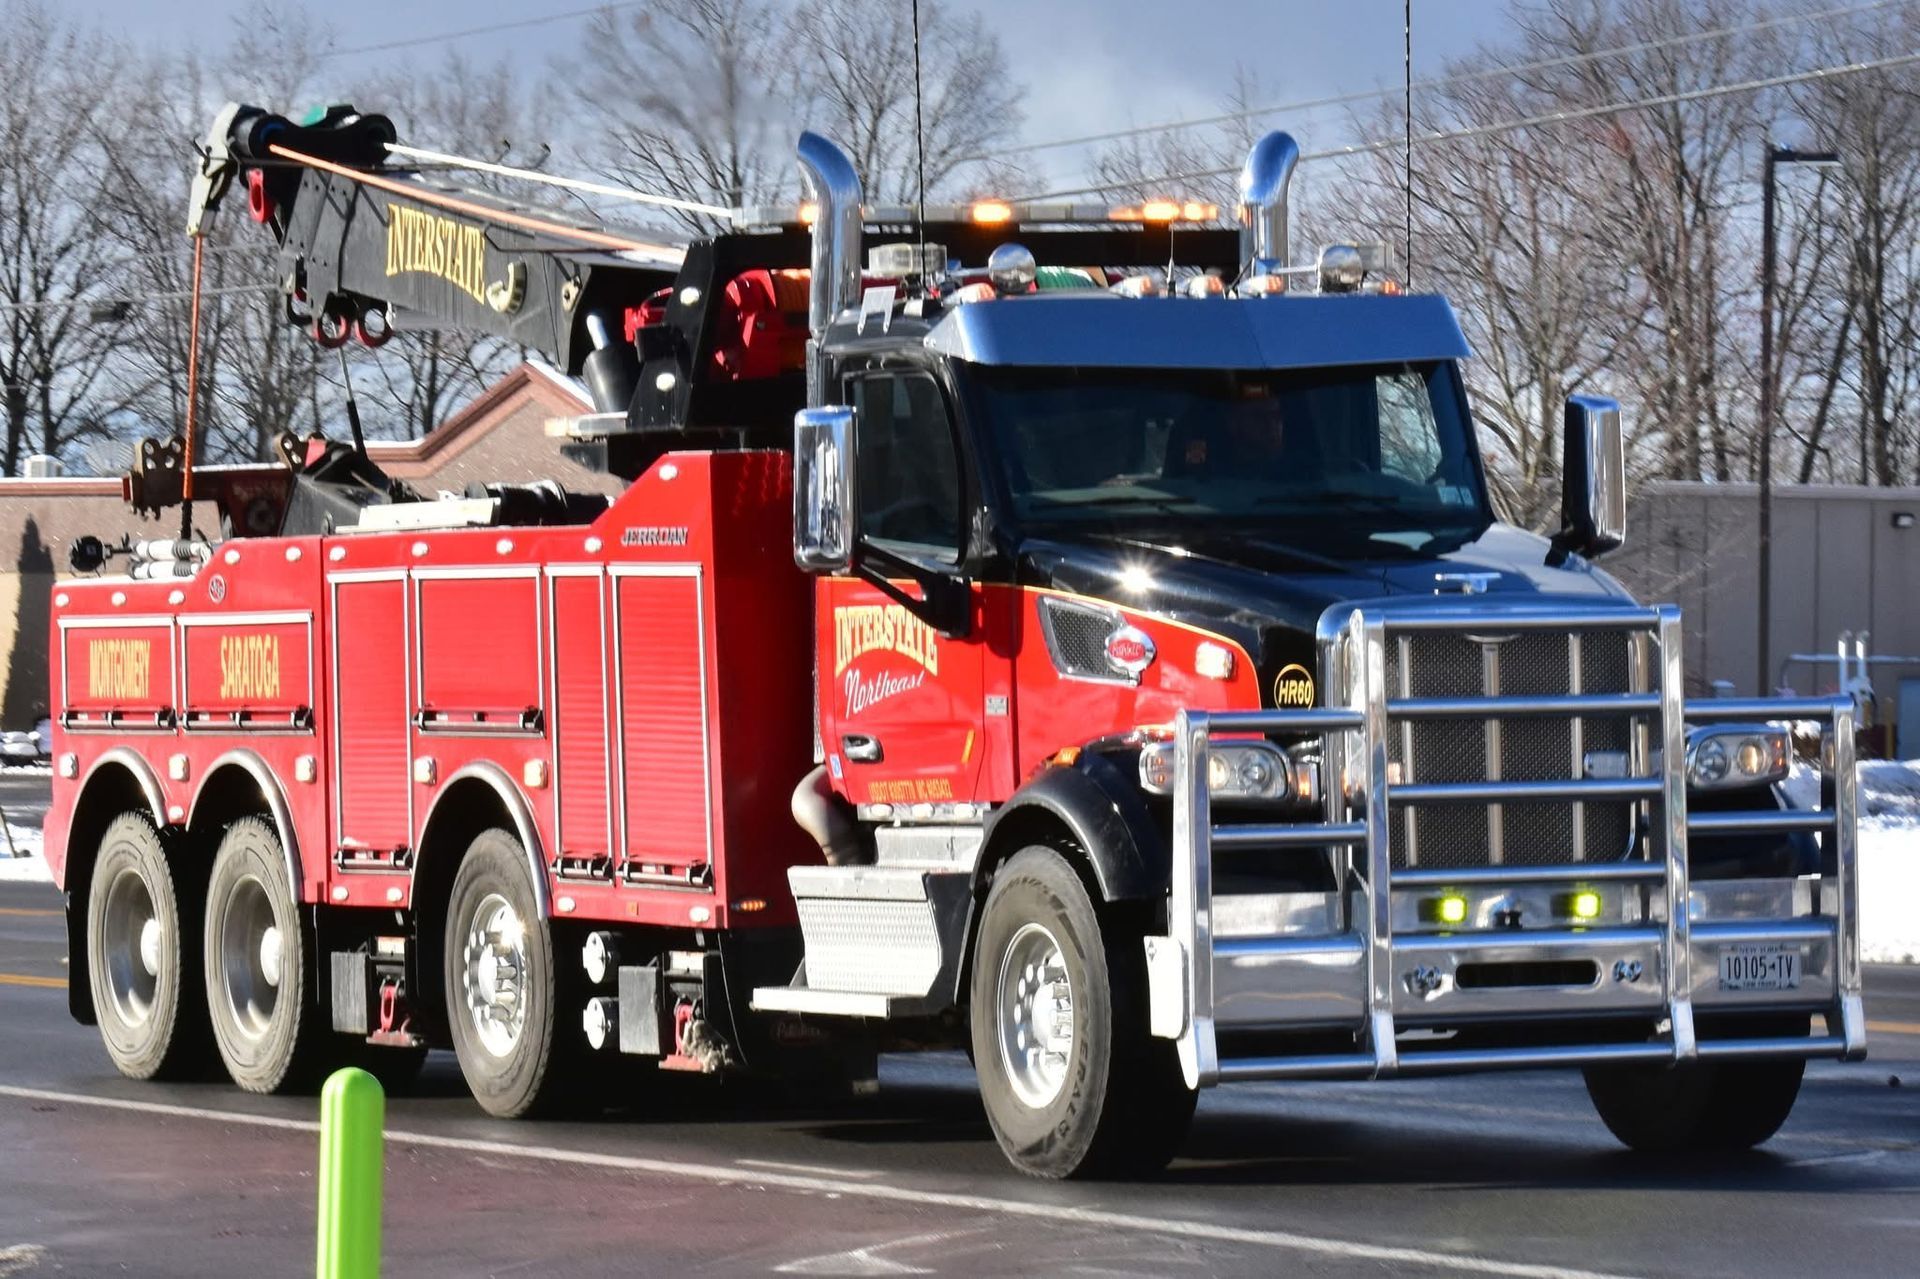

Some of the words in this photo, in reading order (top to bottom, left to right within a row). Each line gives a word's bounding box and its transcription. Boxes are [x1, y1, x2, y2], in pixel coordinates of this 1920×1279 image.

[386, 203, 485, 305] INTERSTATE
[89, 638, 151, 699] MONTGOMERY
[220, 634, 281, 699] SARATOGA
[834, 603, 938, 679] INTERSTATE
[844, 668, 925, 720] Northeast
[1278, 679, 1312, 705] HR60
